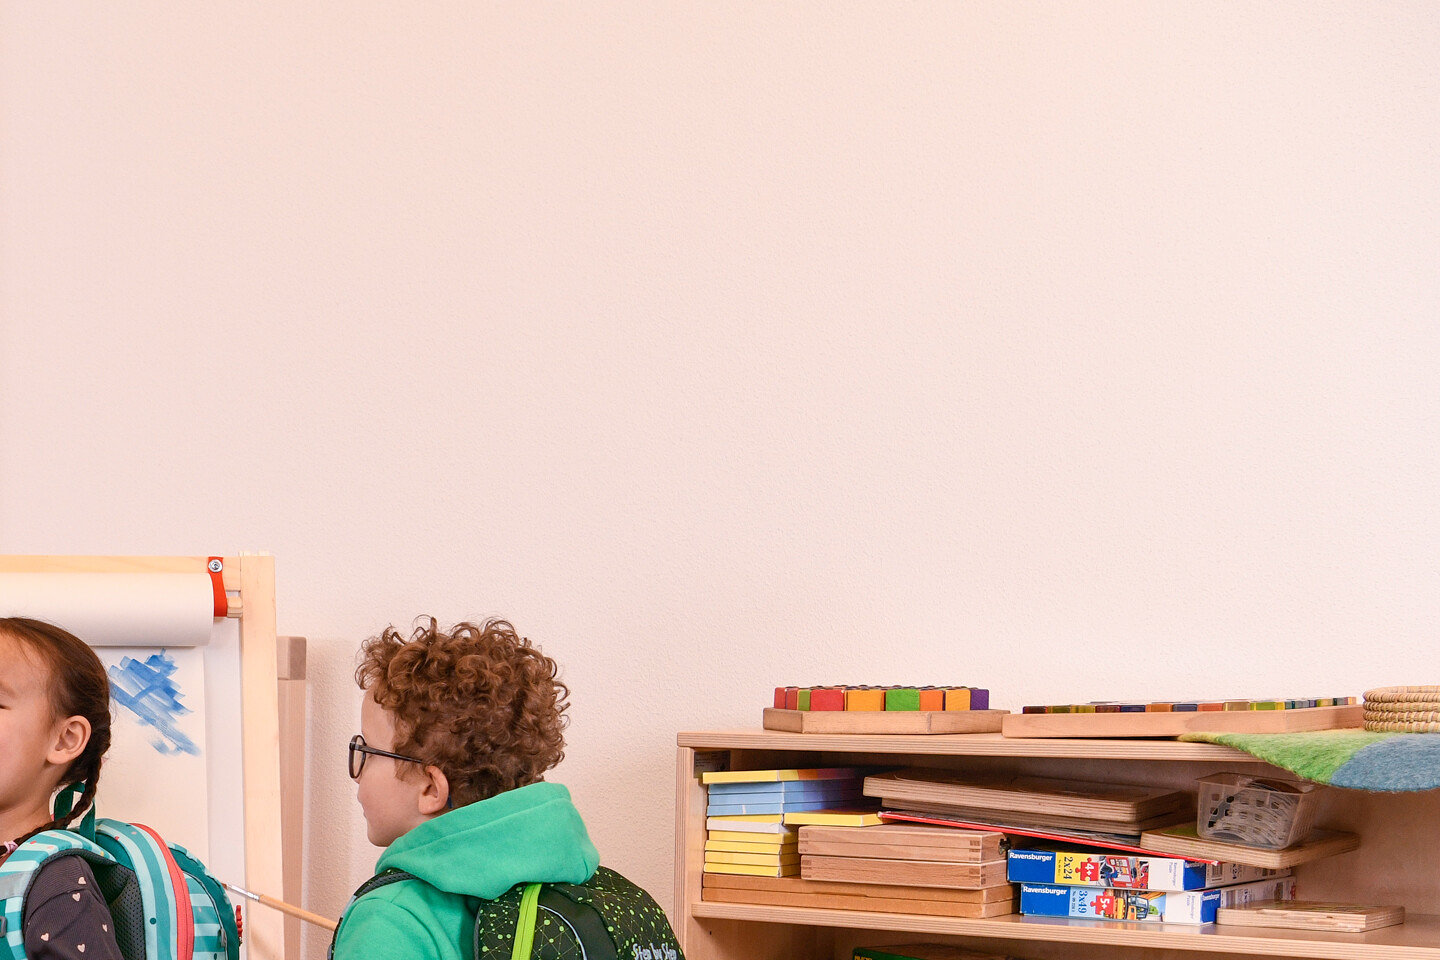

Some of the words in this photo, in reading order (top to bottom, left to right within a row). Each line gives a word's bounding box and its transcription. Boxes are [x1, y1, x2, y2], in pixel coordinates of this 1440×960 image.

[1010, 852, 1053, 862] Ravensburger
[1063, 856, 1073, 879] 2x24
[1023, 886, 1067, 896] Ravensburger
[1078, 890, 1088, 914] 3x49
